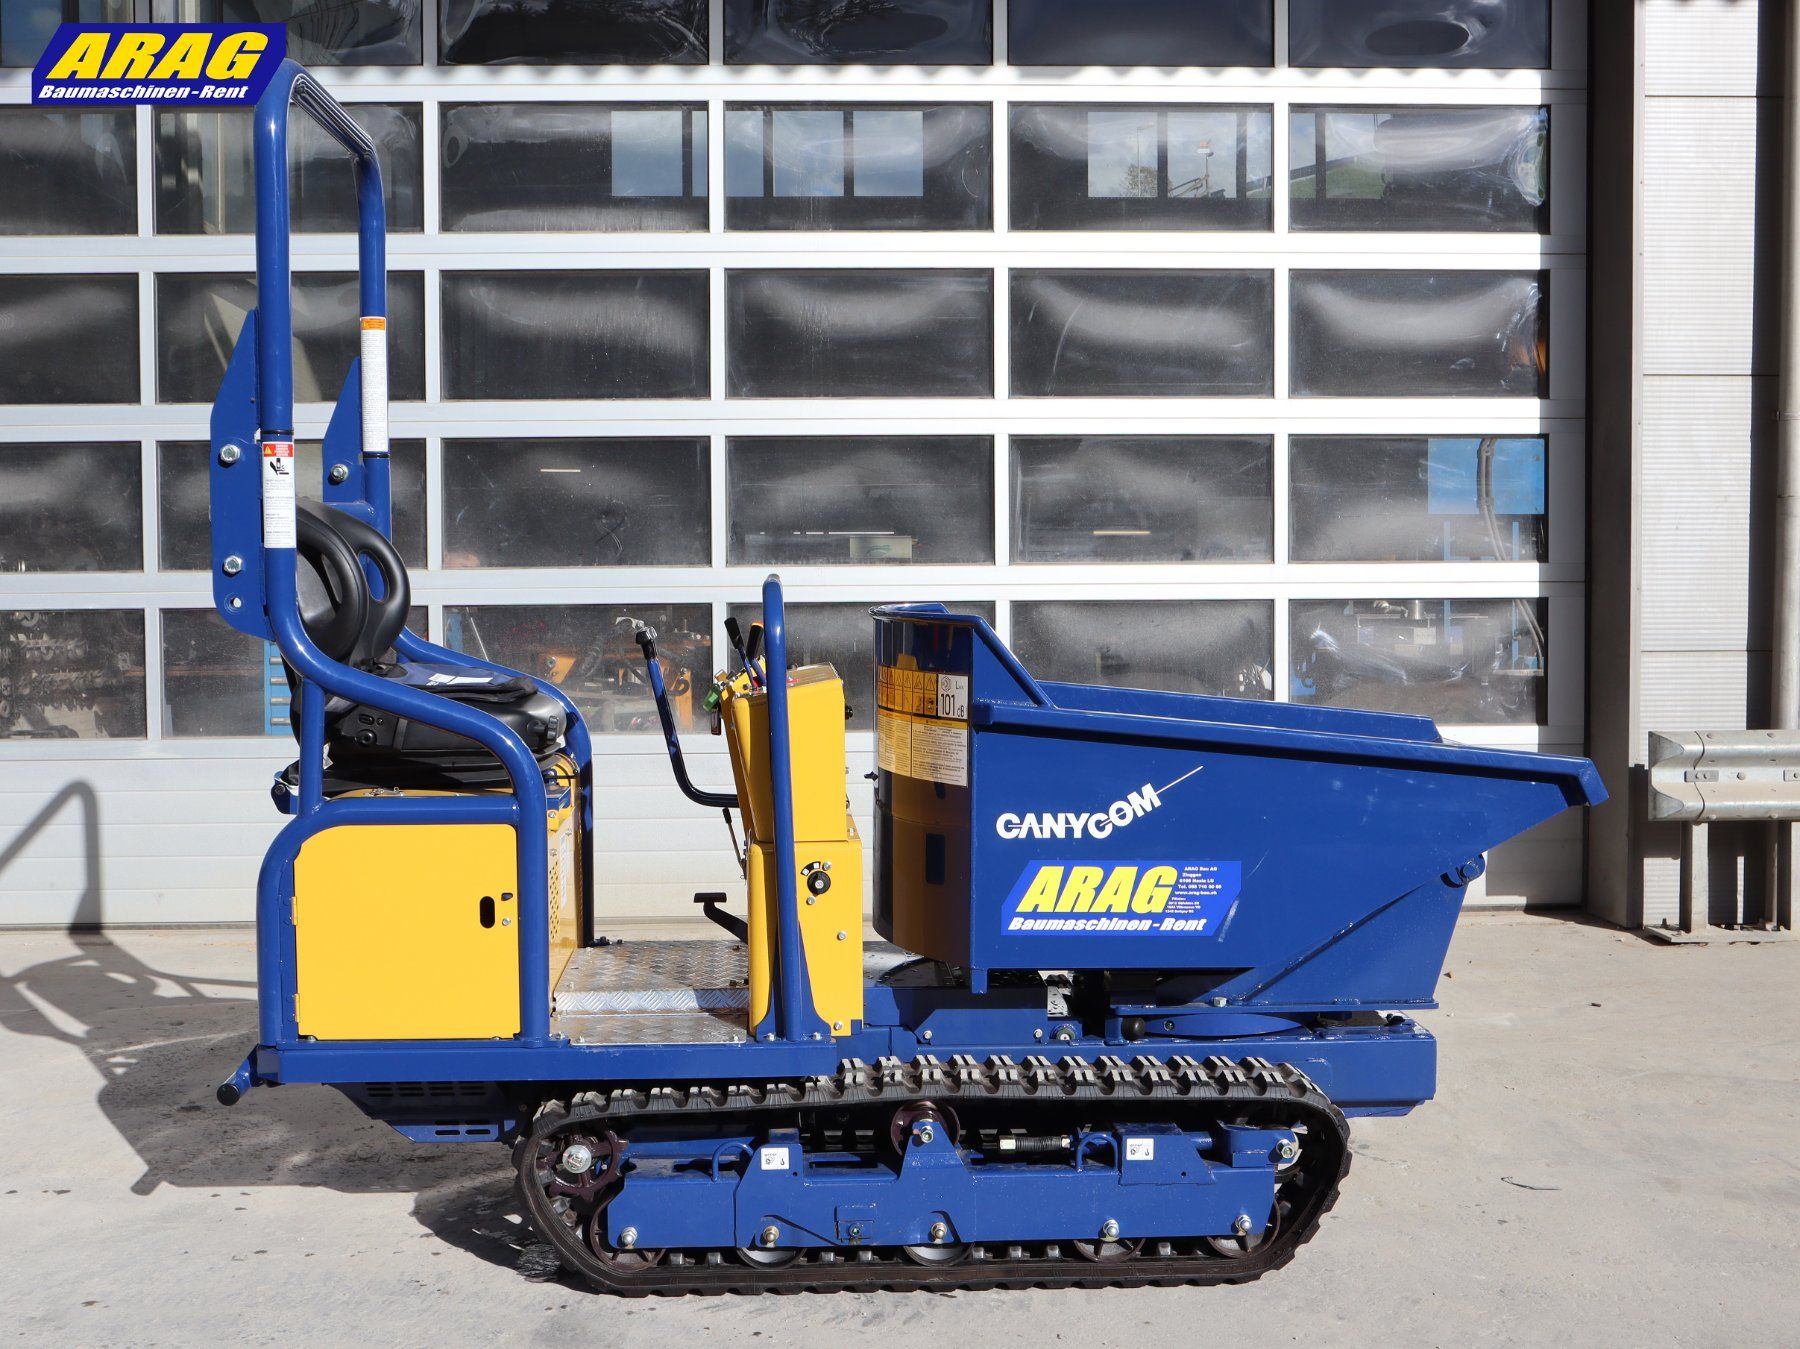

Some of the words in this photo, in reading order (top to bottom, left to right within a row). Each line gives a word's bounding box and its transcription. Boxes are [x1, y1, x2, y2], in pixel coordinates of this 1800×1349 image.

[940, 694, 956, 716] 101
[995, 782, 1162, 839] CANYCOM
[1016, 865, 1178, 914] ARAG
[1008, 917, 1207, 932] Baumaschinen-Rent
